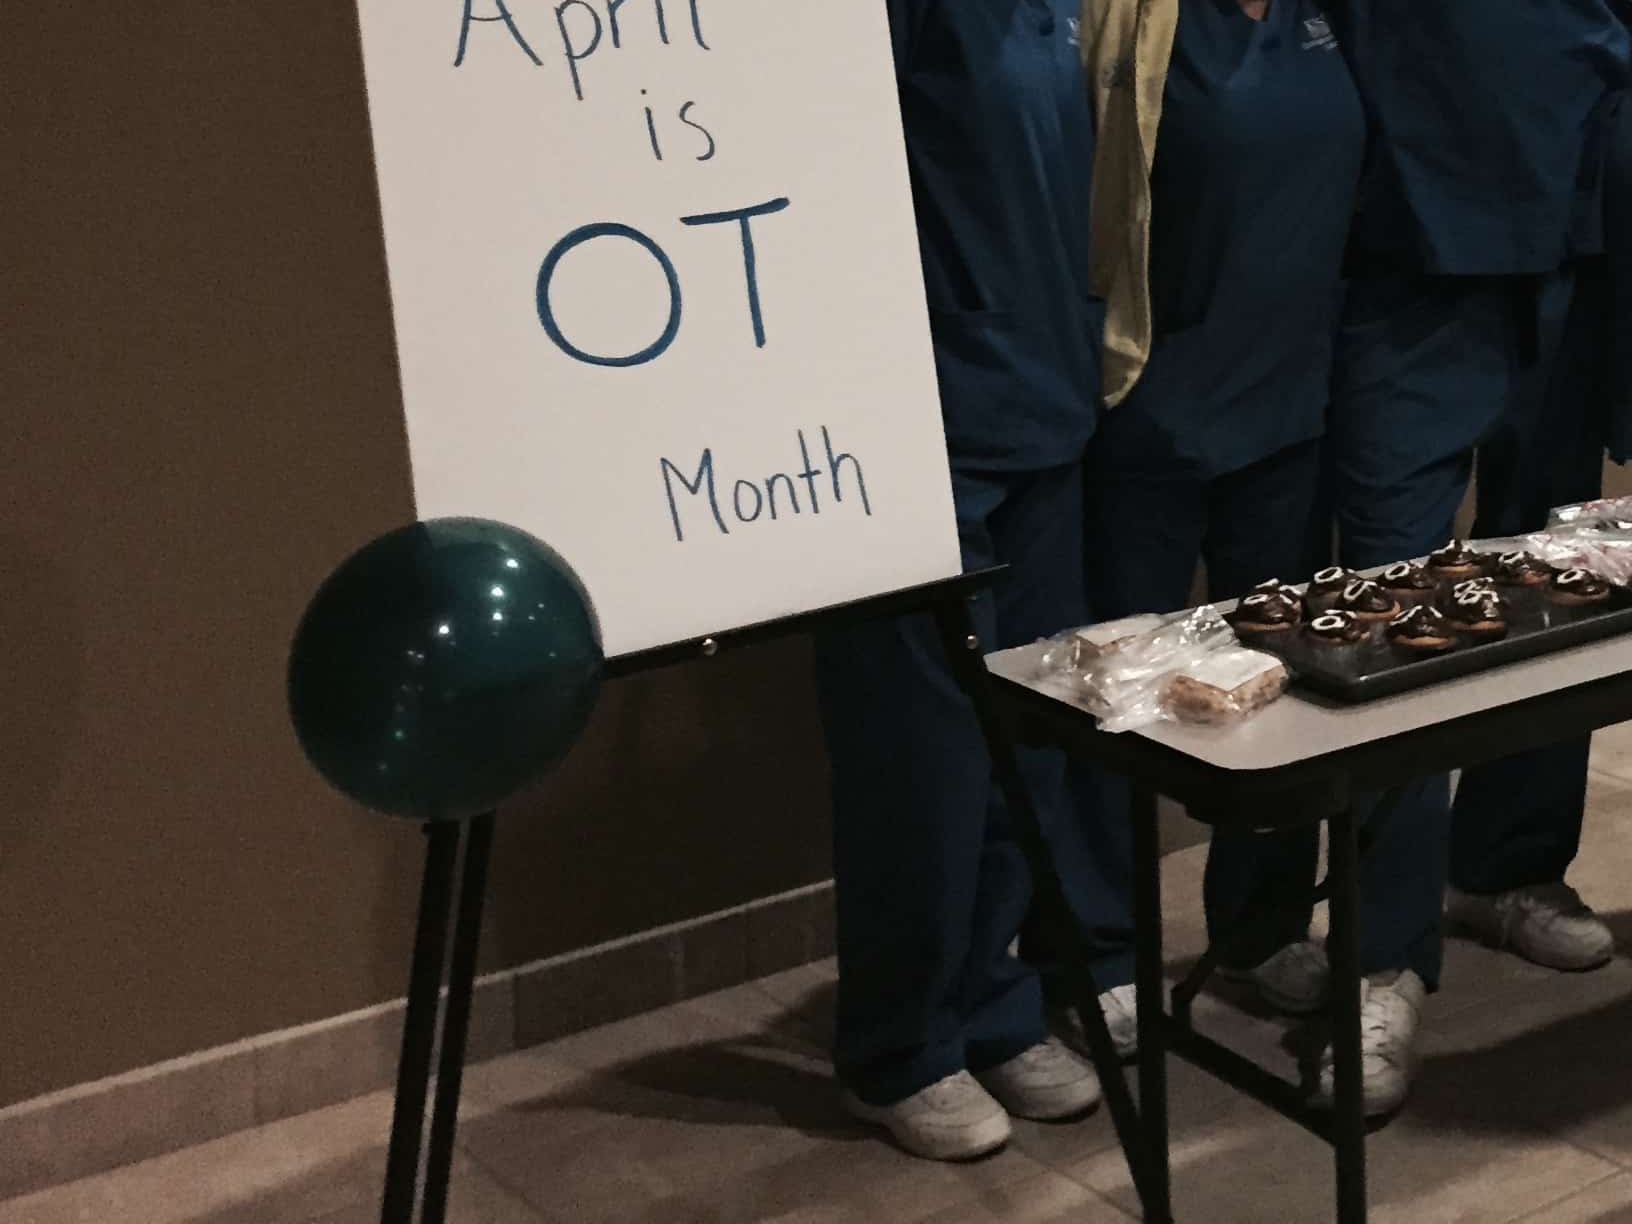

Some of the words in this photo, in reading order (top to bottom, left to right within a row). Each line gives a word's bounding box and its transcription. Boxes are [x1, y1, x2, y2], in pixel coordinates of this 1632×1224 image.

[641, 89, 715, 161] is
[536, 197, 790, 367] OT
[660, 426, 871, 541] Month
